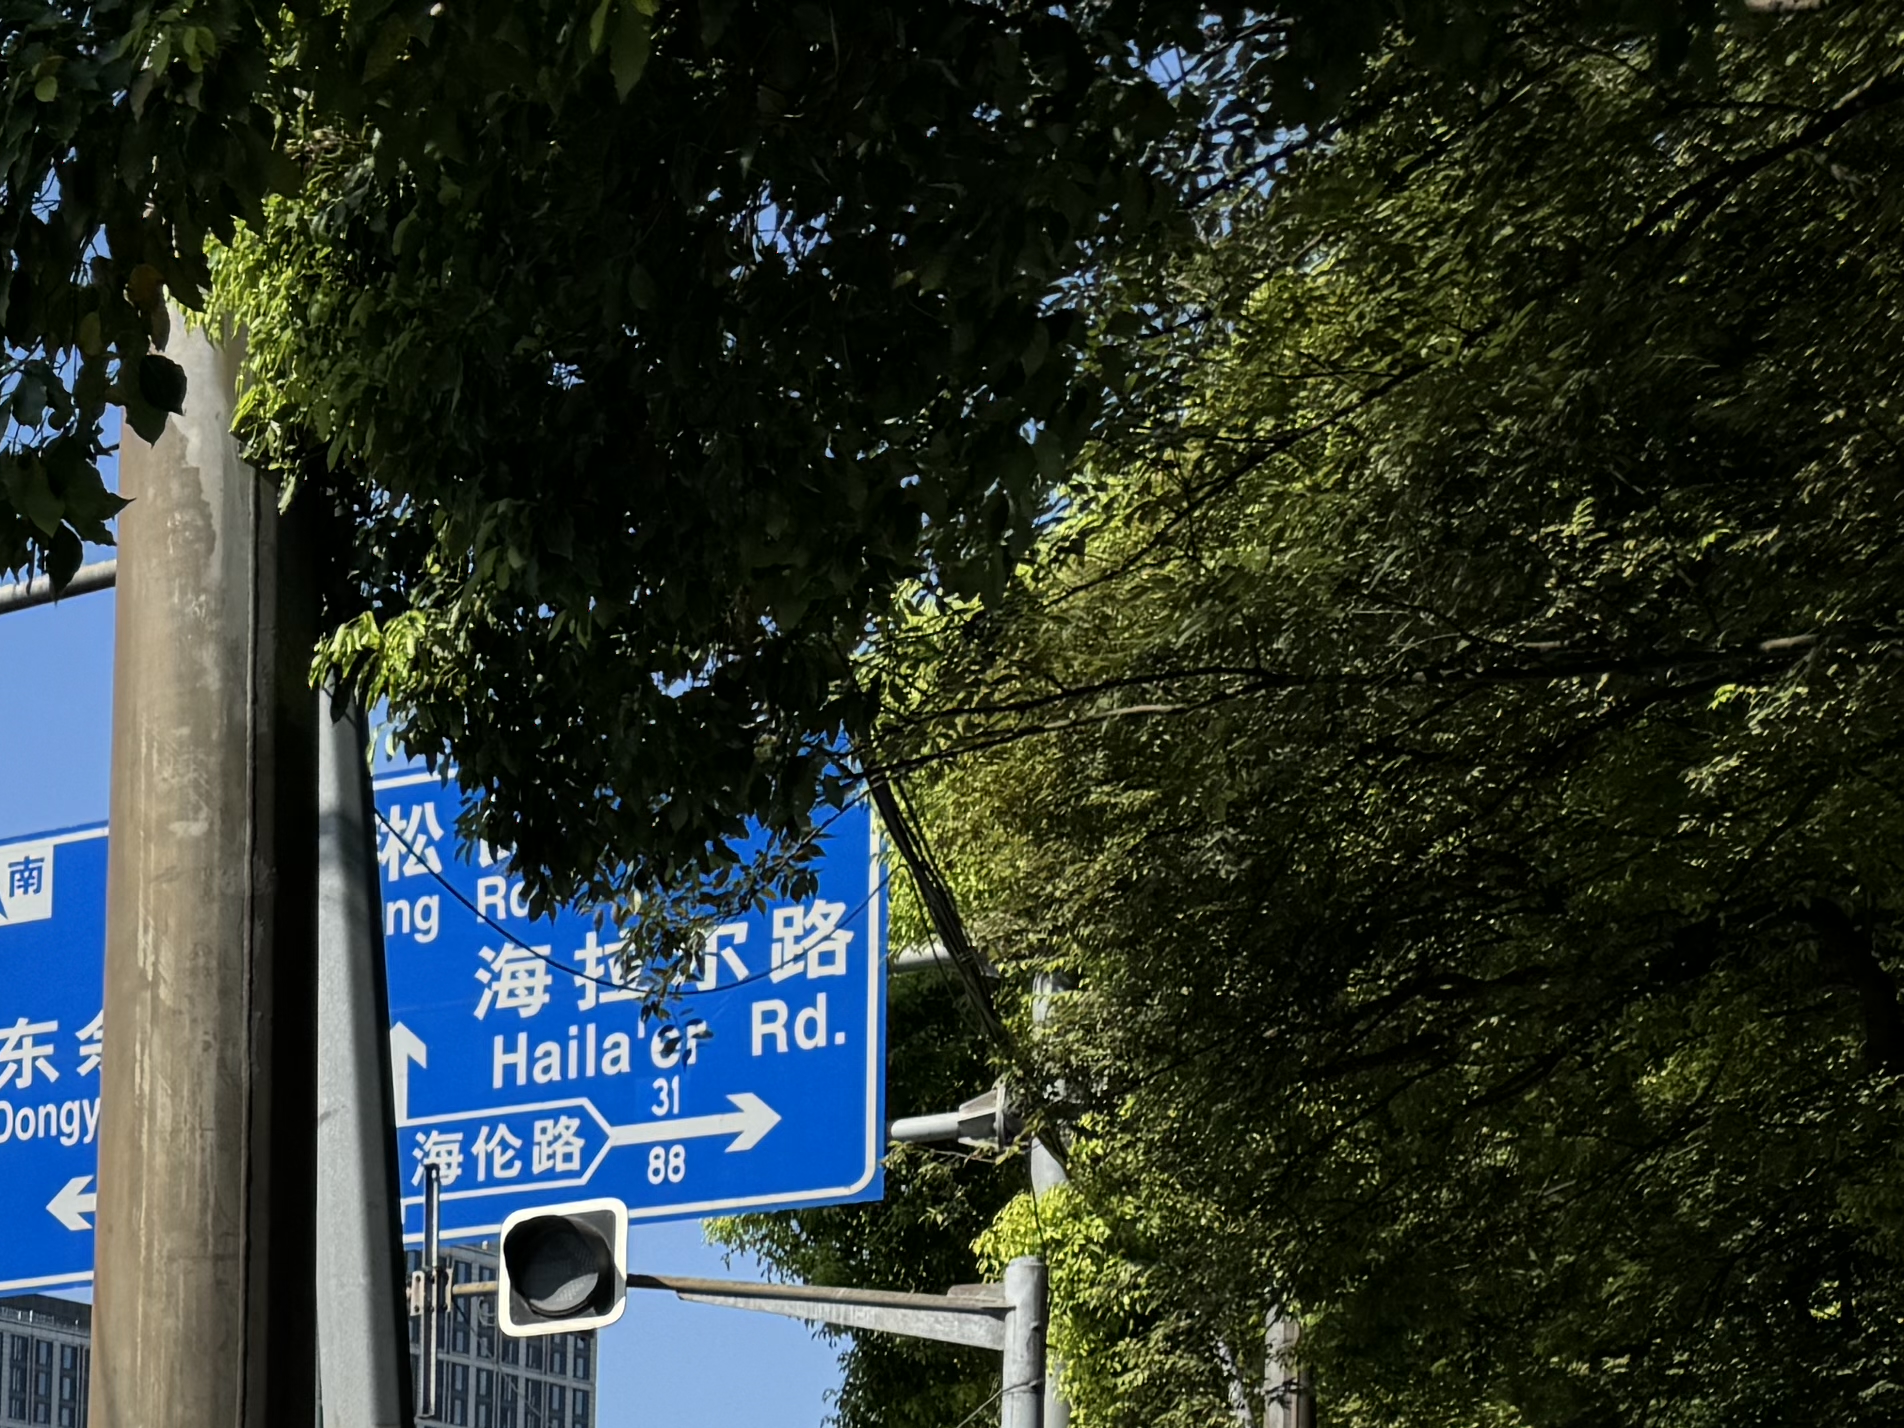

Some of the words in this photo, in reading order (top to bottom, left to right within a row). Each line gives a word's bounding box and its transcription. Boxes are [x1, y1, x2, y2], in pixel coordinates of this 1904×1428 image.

[8, 855, 47, 897] 南
[474, 898, 854, 1020] 海拉尔路
[493, 1019, 699, 1089] Haila'er
[751, 993, 846, 1057] Rd.
[651, 1075, 681, 1118] 31
[411, 1114, 586, 1187] 海伦路
[647, 1144, 686, 1186] 88
